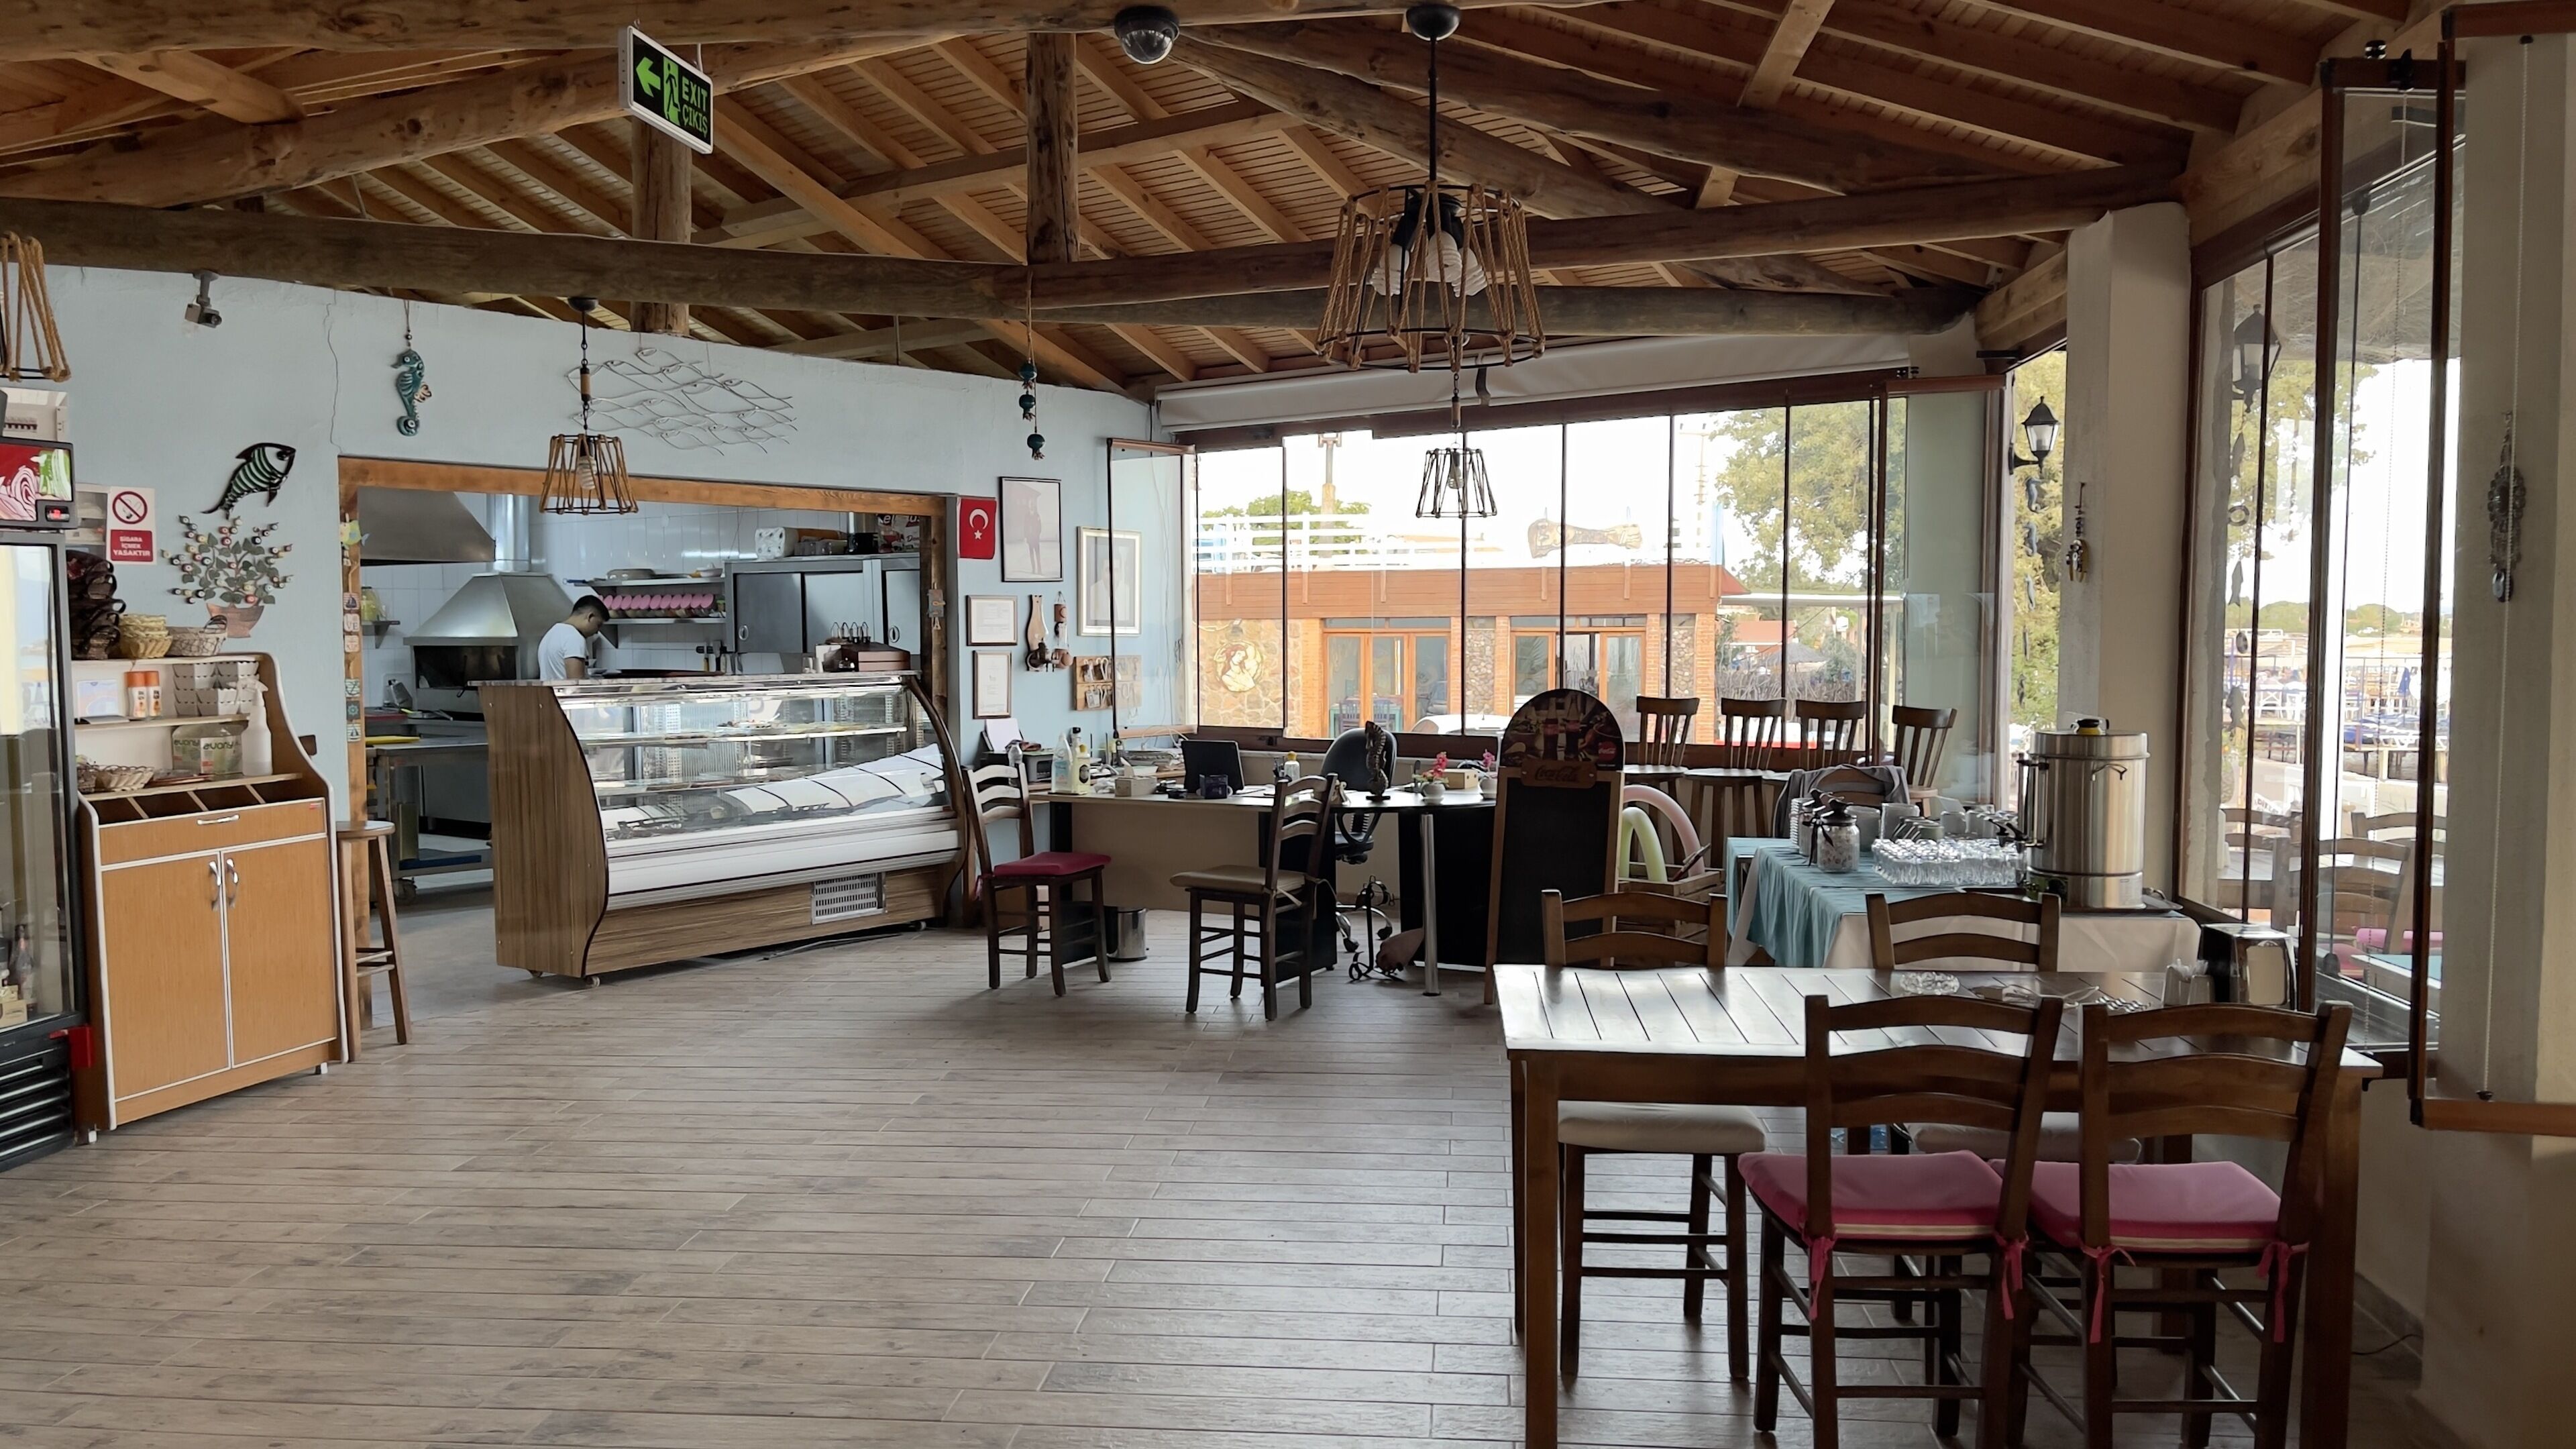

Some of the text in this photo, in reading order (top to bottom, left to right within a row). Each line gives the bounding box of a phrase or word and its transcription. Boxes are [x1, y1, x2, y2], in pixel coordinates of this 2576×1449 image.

[682, 76, 708, 112] EXIT
[682, 103, 708, 138] ÇIKIŞ
[113, 549, 151, 557] YASAKTIR
